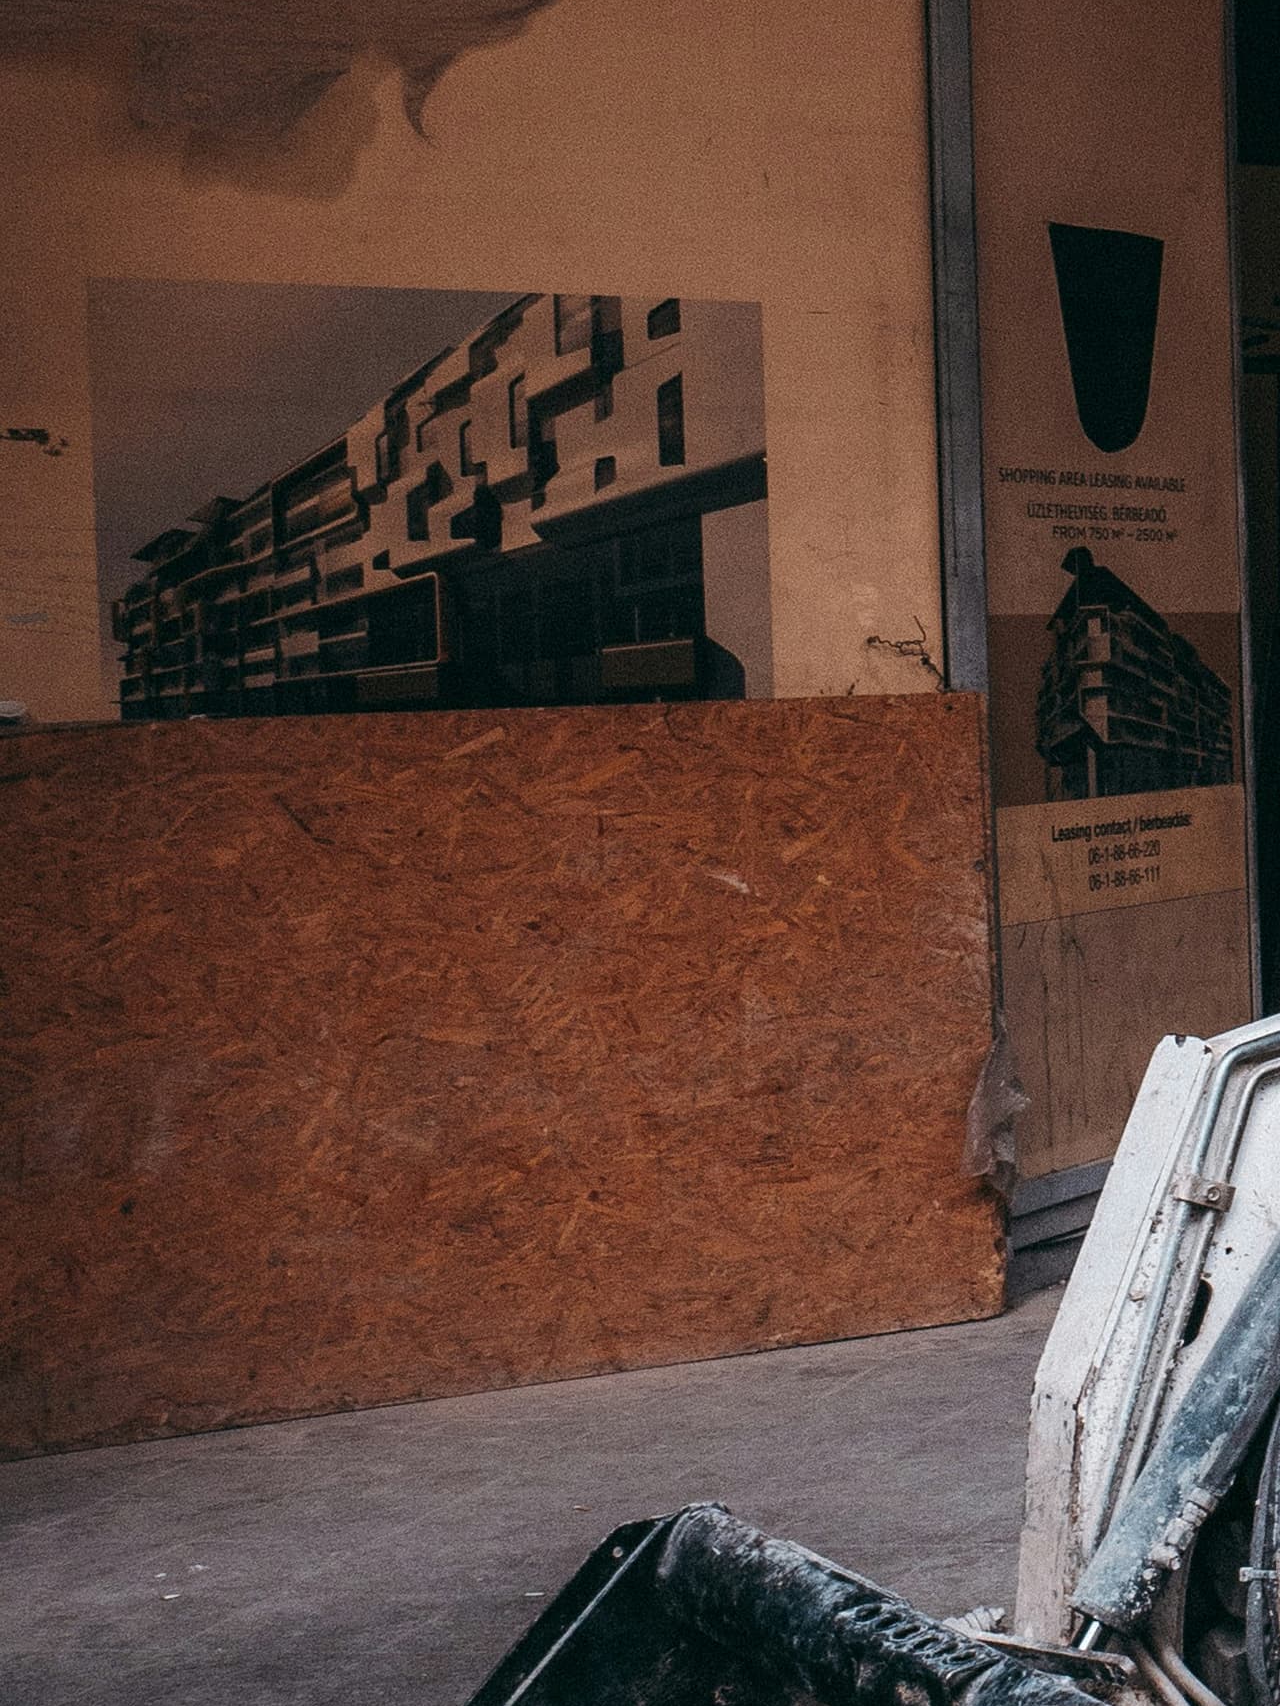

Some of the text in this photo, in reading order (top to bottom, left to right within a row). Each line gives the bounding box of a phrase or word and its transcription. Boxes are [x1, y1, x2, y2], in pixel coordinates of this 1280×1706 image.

[998, 467, 1186, 493] SHOPPING AREA LEASING AVAILABLE
[1052, 525, 1086, 541] FROM
[1089, 526, 1109, 541] 750
[1135, 528, 1163, 542] 2500
[1051, 822, 1092, 843] Leasing
[1093, 818, 1132, 838] contact
